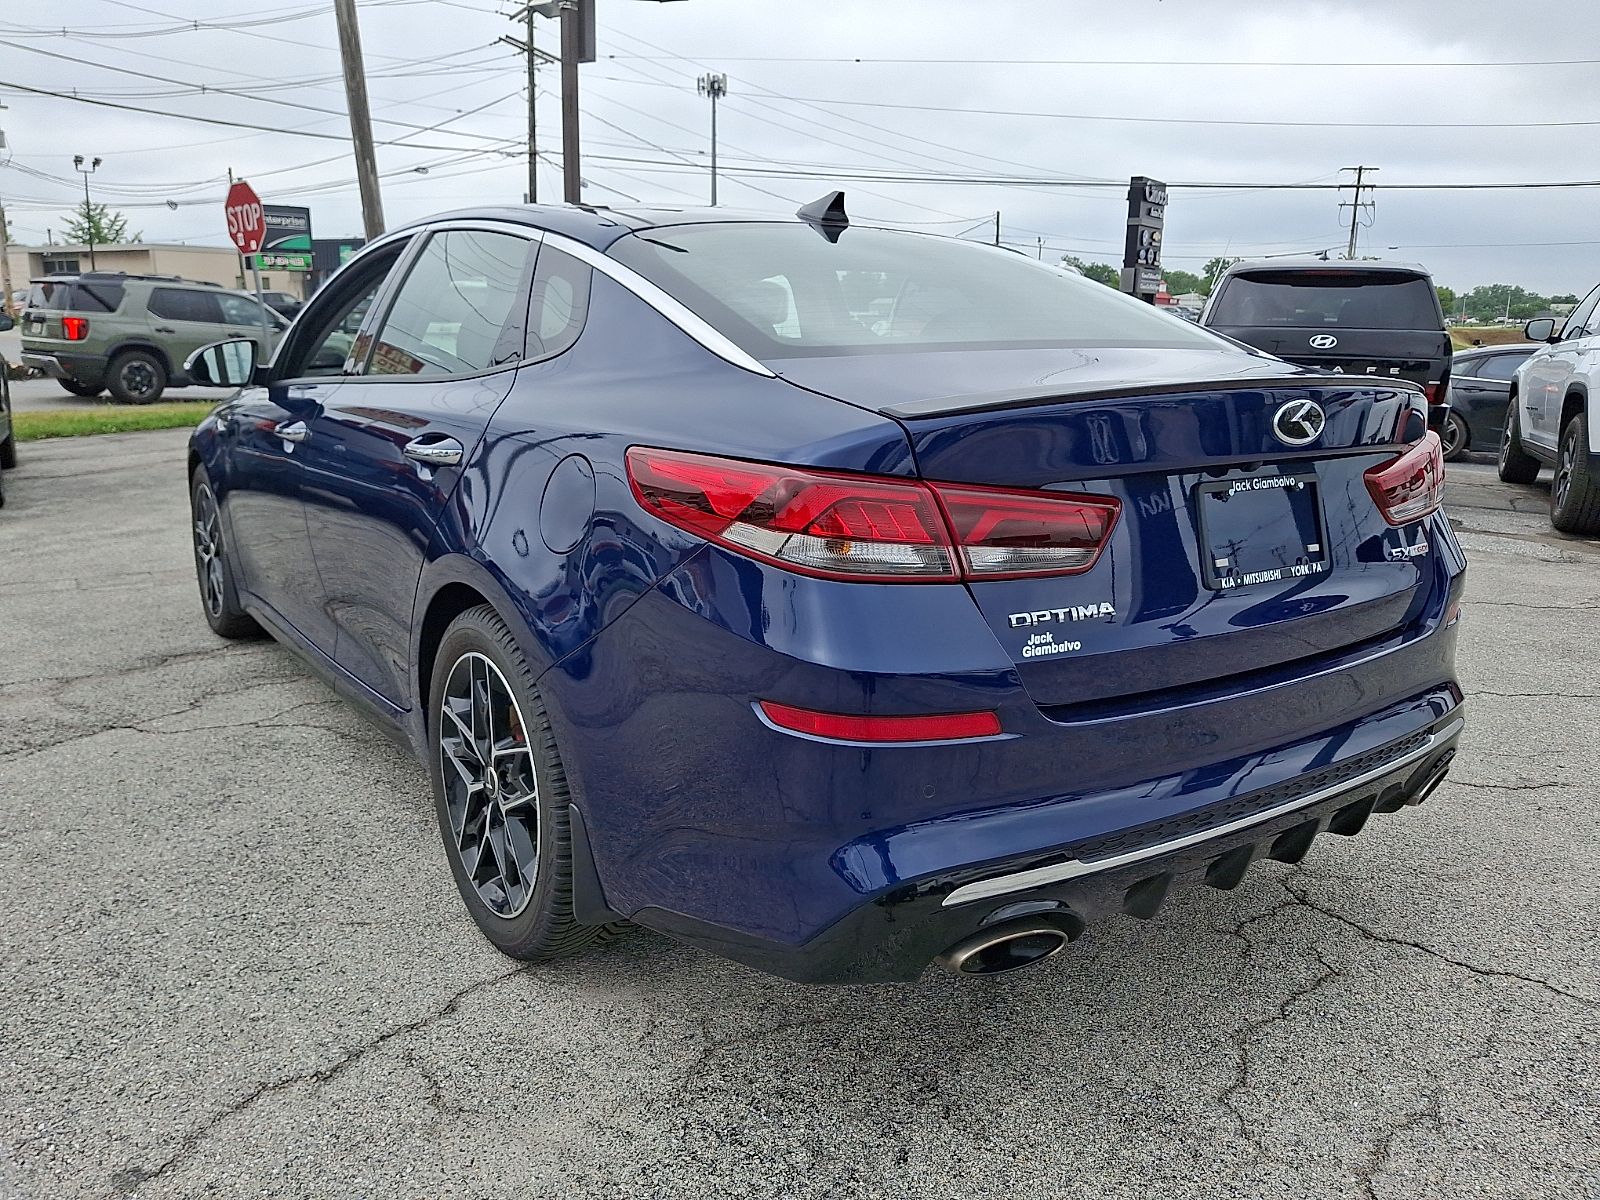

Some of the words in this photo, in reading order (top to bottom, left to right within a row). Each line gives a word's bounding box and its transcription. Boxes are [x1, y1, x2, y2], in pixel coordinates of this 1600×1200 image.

[227, 203, 260, 234] STOP
[265, 215, 305, 226] nterprise
[1231, 480, 1252, 493] Jack
[1253, 476, 1296, 490] Giambalvo
[1221, 577, 1236, 589] KIA
[1243, 571, 1282, 585] MITSUBISHI
[1312, 562, 1323, 573] PA
[1008, 602, 1116, 627] OPTIMA
[1028, 632, 1053, 645] Jack
[1022, 641, 1081, 657] Giambalvo
